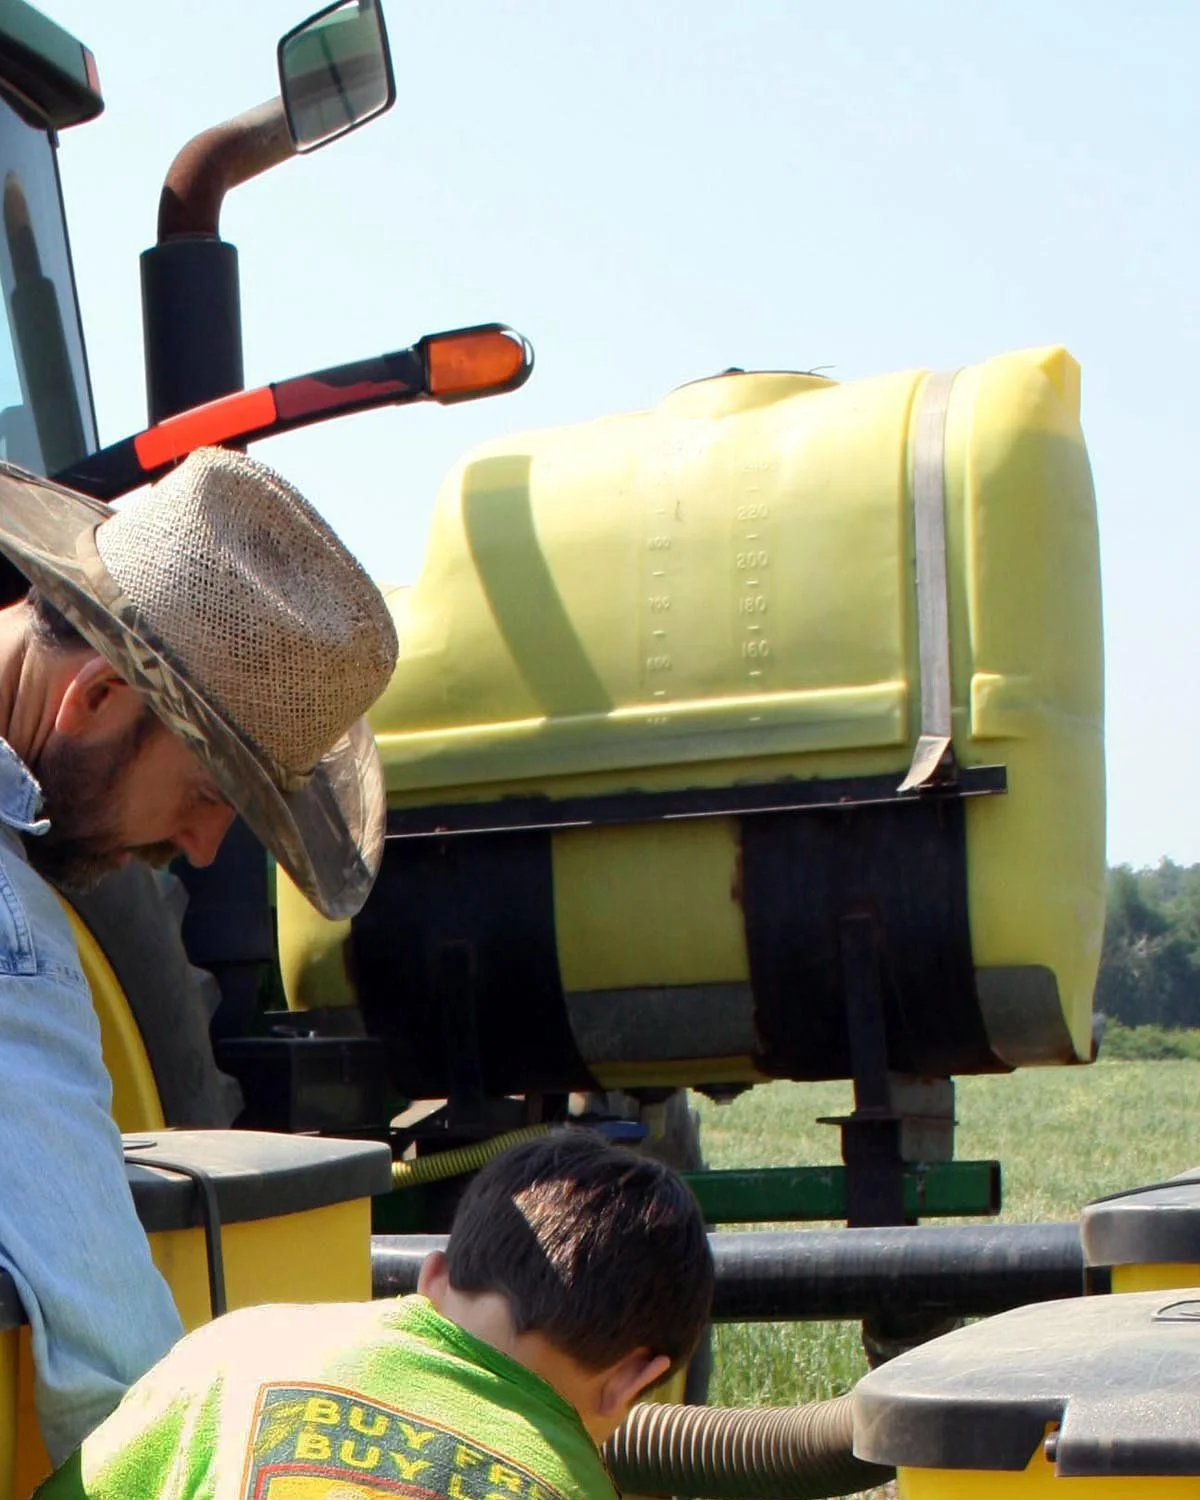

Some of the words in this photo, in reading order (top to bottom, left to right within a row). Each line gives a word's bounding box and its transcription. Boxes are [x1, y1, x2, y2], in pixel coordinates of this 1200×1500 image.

[736, 550, 769, 569] 200
[738, 595, 767, 614] 180
[302, 1396, 436, 1450] BUY
[294, 1430, 432, 1481] BUY
